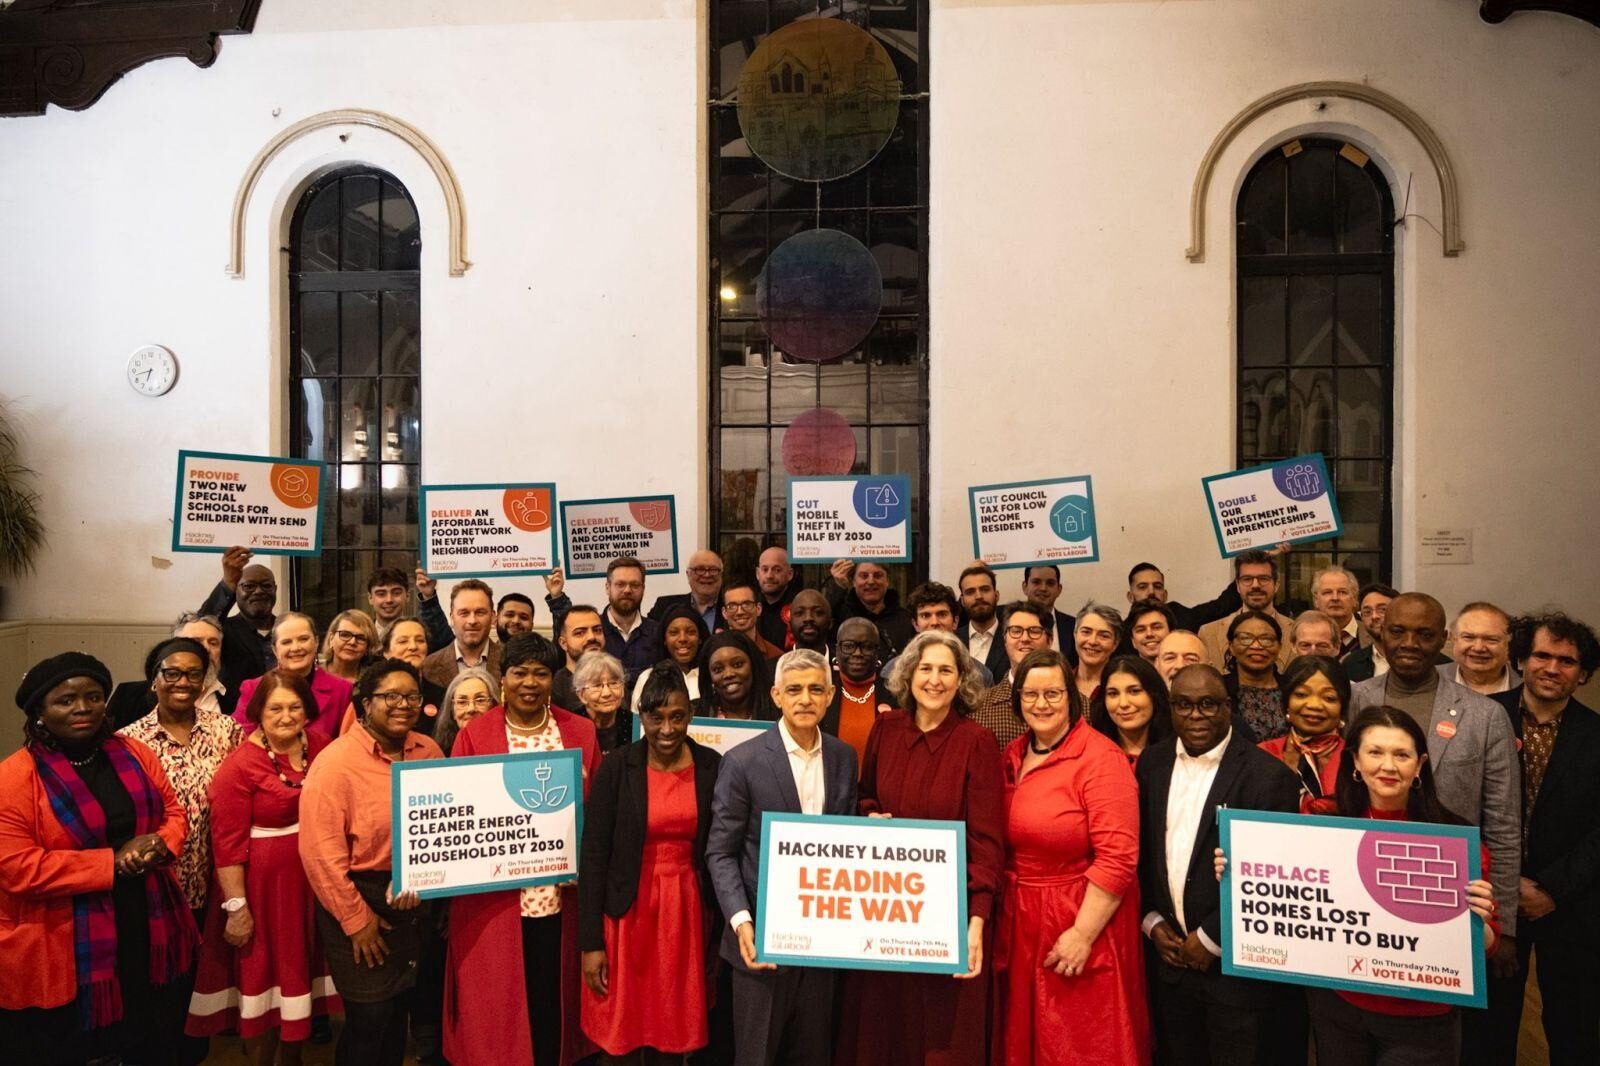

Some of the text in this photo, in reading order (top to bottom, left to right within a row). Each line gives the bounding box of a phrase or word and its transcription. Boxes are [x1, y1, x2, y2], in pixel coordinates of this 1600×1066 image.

[190, 470, 240, 481] PROVIDE
[190, 481, 247, 492] TWO NEW
[189, 492, 236, 502] SPECIAL
[980, 491, 1047, 504] CUT COUNCIL
[1218, 494, 1257, 509] DOUBLE
[188, 502, 269, 514] SCHOOLS FOR
[797, 500, 819, 508] CUT
[1001, 503, 1020, 512] FOR
[1023, 501, 1046, 510] LOW
[432, 510, 472, 518] DELIVER
[797, 511, 838, 519] MOBILE
[981, 513, 1020, 523] INCOME
[1221, 507, 1242, 517] OUR
[1223, 508, 1284, 527] INVESTMENT
[1287, 505, 1298, 514] IN
[187, 513, 306, 526] CHILDREN WITH SEND
[432, 518, 494, 527] AFFORDABLE
[571, 517, 619, 526] CELEBRATE
[797, 521, 845, 530] THEFT IN
[1226, 511, 1315, 536] APPRENTICESHIPS
[432, 527, 512, 536] FOOD NETWORK
[593, 525, 631, 533] CULTURE
[982, 521, 1034, 533] RESIDENTS
[1291, 528, 1307, 536] VOTE
[1307, 524, 1331, 534] LABOUR
[445, 538, 474, 546] EVERY
[592, 532, 653, 541] COMMUNITIES
[797, 532, 872, 541] HALF BY 2030
[432, 546, 519, 555] NEIGHBOURHOOD
[594, 550, 637, 558] BOROUGH
[408, 793, 454, 807] BRING
[409, 806, 474, 821] CHEAPER
[409, 814, 532, 835] CLEANER ENERGY
[409, 828, 539, 850] TO 4500 COUNCIL
[409, 840, 564, 865] HOUSEHOLDS BY 2030
[778, 841, 946, 863] HACKNEY LABOUR
[408, 870, 446, 880] Hackney
[508, 863, 568, 876] VOTE LABOUR
[1241, 862, 1330, 884] REPLACE
[799, 867, 925, 895] LEADING
[1241, 881, 1334, 903] COUNCIL
[798, 894, 924, 923] THE WAY
[1241, 899, 1370, 927] HOMES LOST
[772, 932, 812, 944] Hackney
[1242, 918, 1419, 952] TO RIGHT TO BUY
[880, 947, 949, 957] VOTE LABOUR
[1241, 943, 1288, 958] Hackney
[1250, 954, 1287, 966] Labour
[1385, 960, 1424, 972] Thursday
[1426, 964, 1440, 972] 7th
[1442, 966, 1459, 976] May
[1372, 968, 1405, 981] VOTE
[1408, 972, 1461, 987] LABOUR
